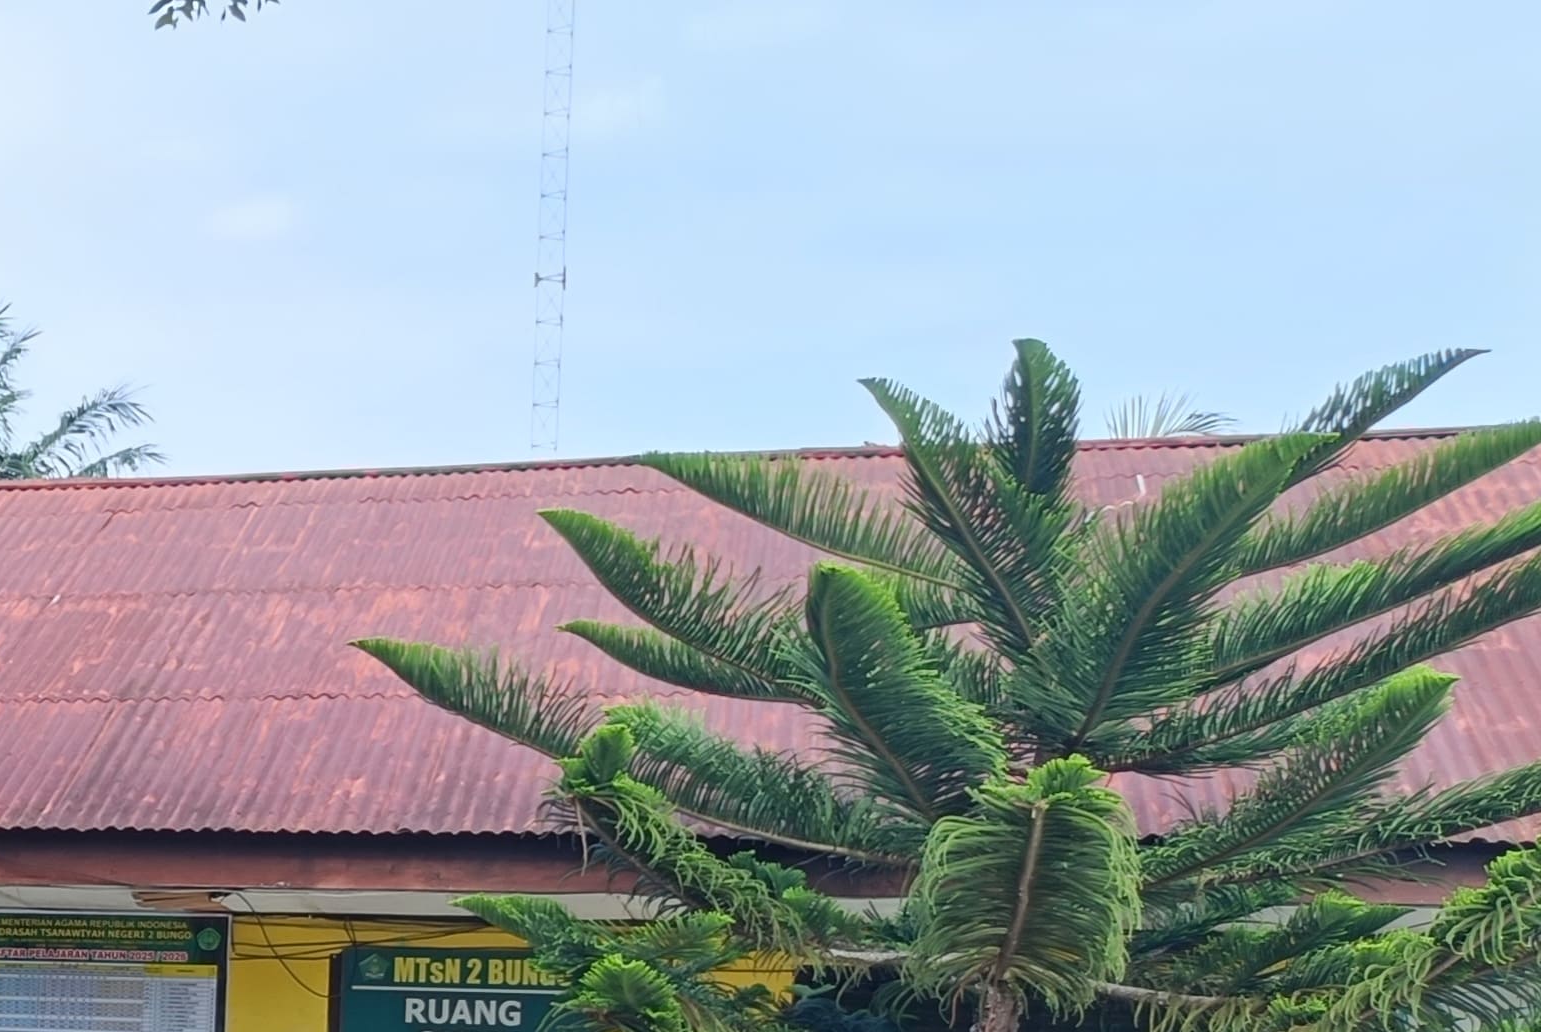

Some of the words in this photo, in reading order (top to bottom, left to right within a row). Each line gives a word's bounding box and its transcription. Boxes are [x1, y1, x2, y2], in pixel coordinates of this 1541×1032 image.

[54, 919, 88, 929] AGAMA
[90, 920, 136, 930] REPUBLIK
[137, 921, 188, 930] INDONESIA
[40, 928, 105, 939] TSANAWIYAH
[107, 929, 145, 939] NEGERI
[148, 930, 155, 939] 2
[156, 930, 192, 940] BUNGO
[28, 949, 89, 960] PELAJARAN
[91, 951, 127, 960] TAHUN
[128, 951, 154, 961] 2025
[393, 956, 461, 984] MTsN
[466, 957, 483, 985] 2
[488, 958, 572, 987] BUNG
[404, 997, 522, 1027] RUANG
